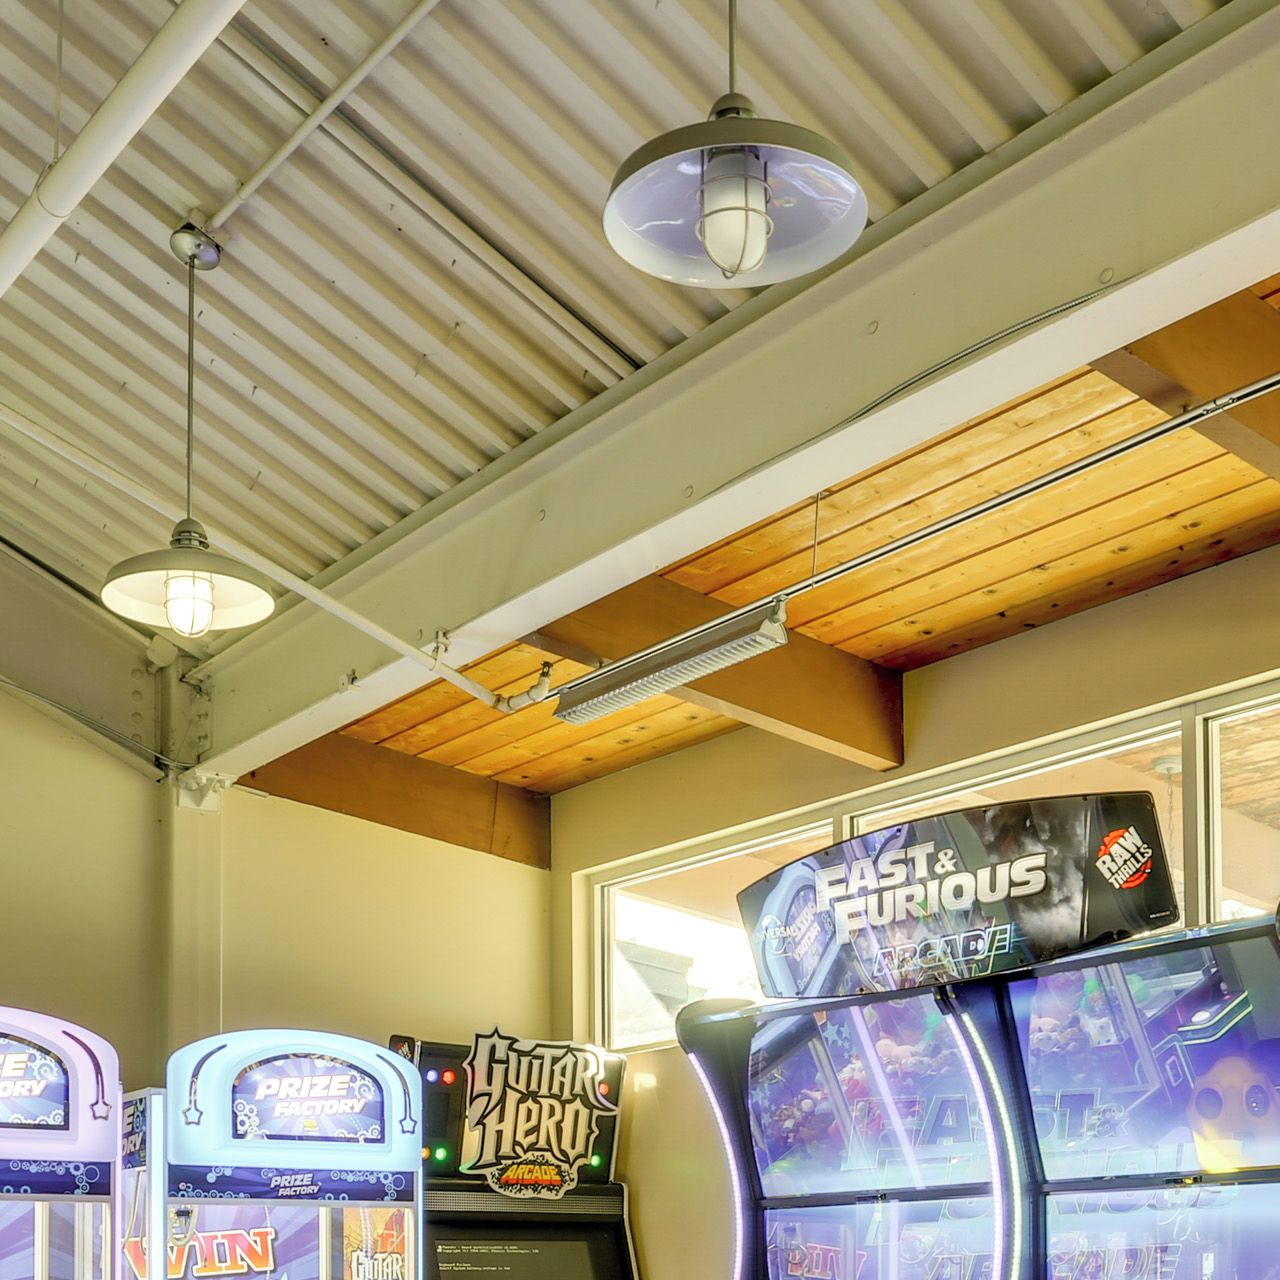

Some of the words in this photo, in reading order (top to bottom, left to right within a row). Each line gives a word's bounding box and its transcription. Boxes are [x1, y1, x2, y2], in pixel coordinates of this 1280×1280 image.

[816, 842, 934, 912] FAST
[934, 847, 958, 874] &
[1095, 826, 1143, 880] RAW
[1108, 843, 1153, 889] THRILLS
[834, 852, 1048, 944] FURIOUS
[874, 924, 1013, 978] ARCADE
[255, 1074, 352, 1100] PRIZE
[469, 1034, 608, 1114] GUITAR
[273, 1098, 366, 1118] FACTORY
[270, 1172, 313, 1188] PRIZE
[278, 1184, 320, 1197] FACTORY
[500, 1163, 562, 1185] ARCADE
[124, 1228, 276, 1279] WIN
